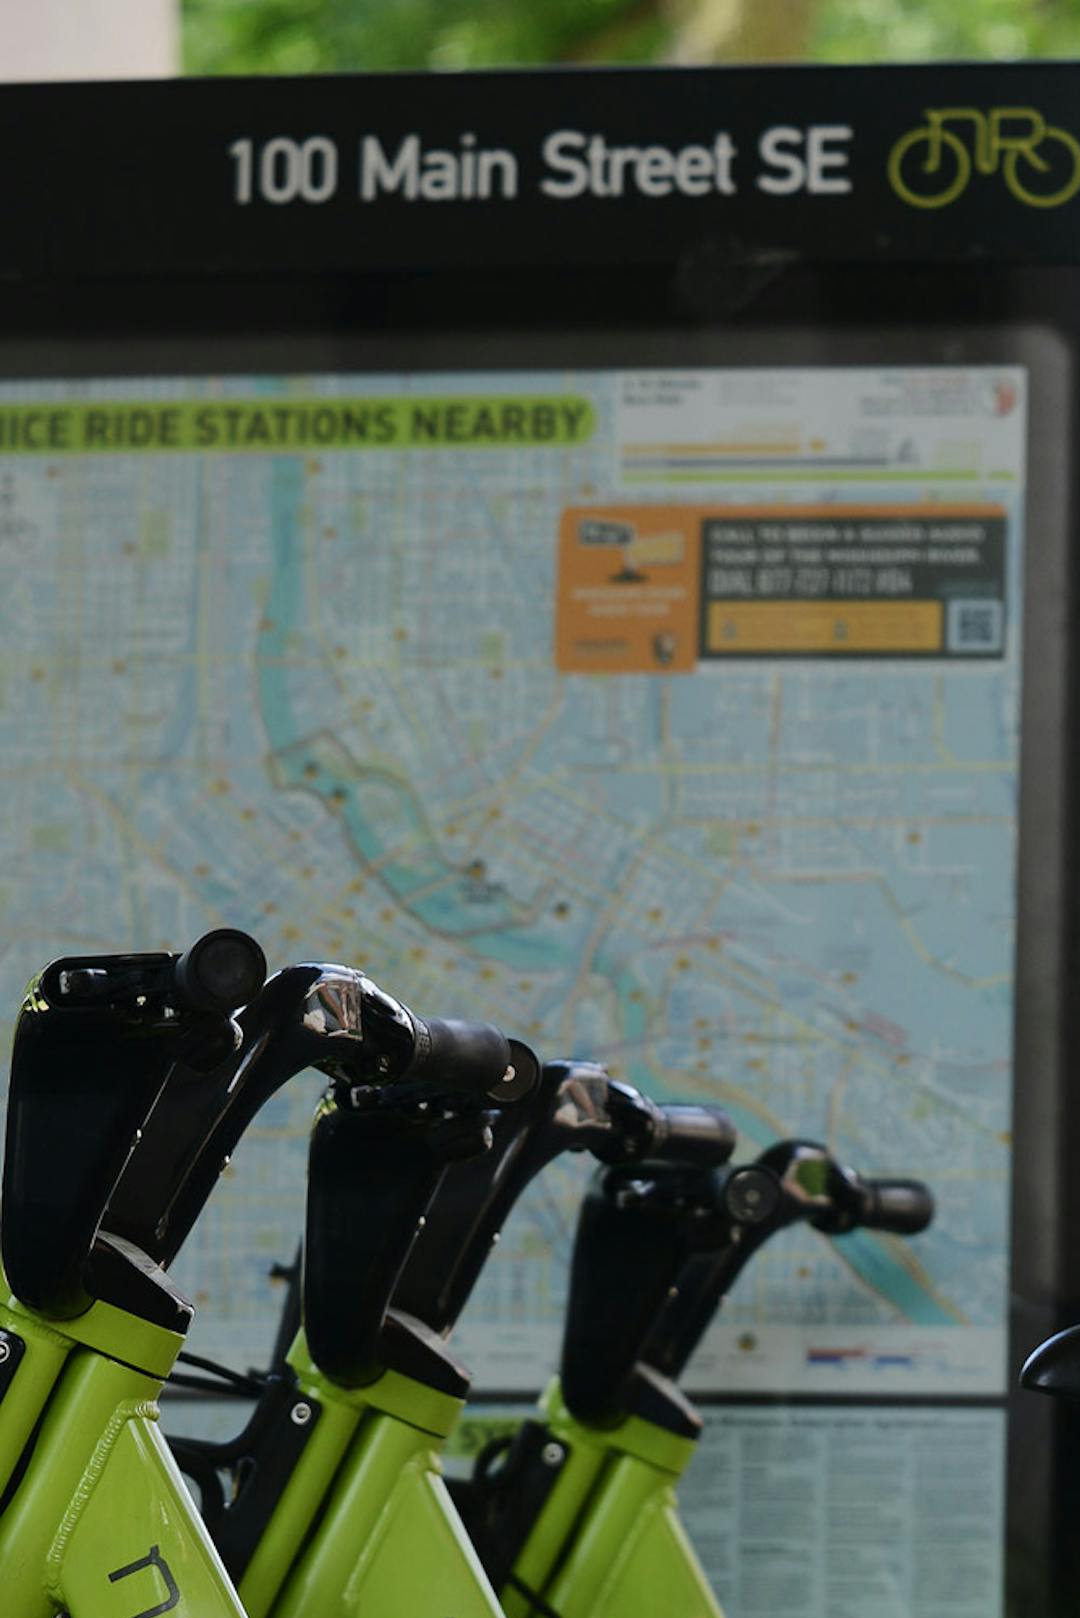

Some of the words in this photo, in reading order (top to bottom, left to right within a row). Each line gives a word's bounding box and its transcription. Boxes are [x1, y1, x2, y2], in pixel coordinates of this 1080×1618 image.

[229, 136, 338, 205] 100
[360, 133, 518, 202] Main
[540, 130, 738, 199] Street
[757, 126, 853, 195] SE
[0, 409, 71, 448] ICE
[83, 407, 181, 447] RIDE
[195, 405, 398, 446] STATIONS
[411, 403, 586, 443] NEARBY
